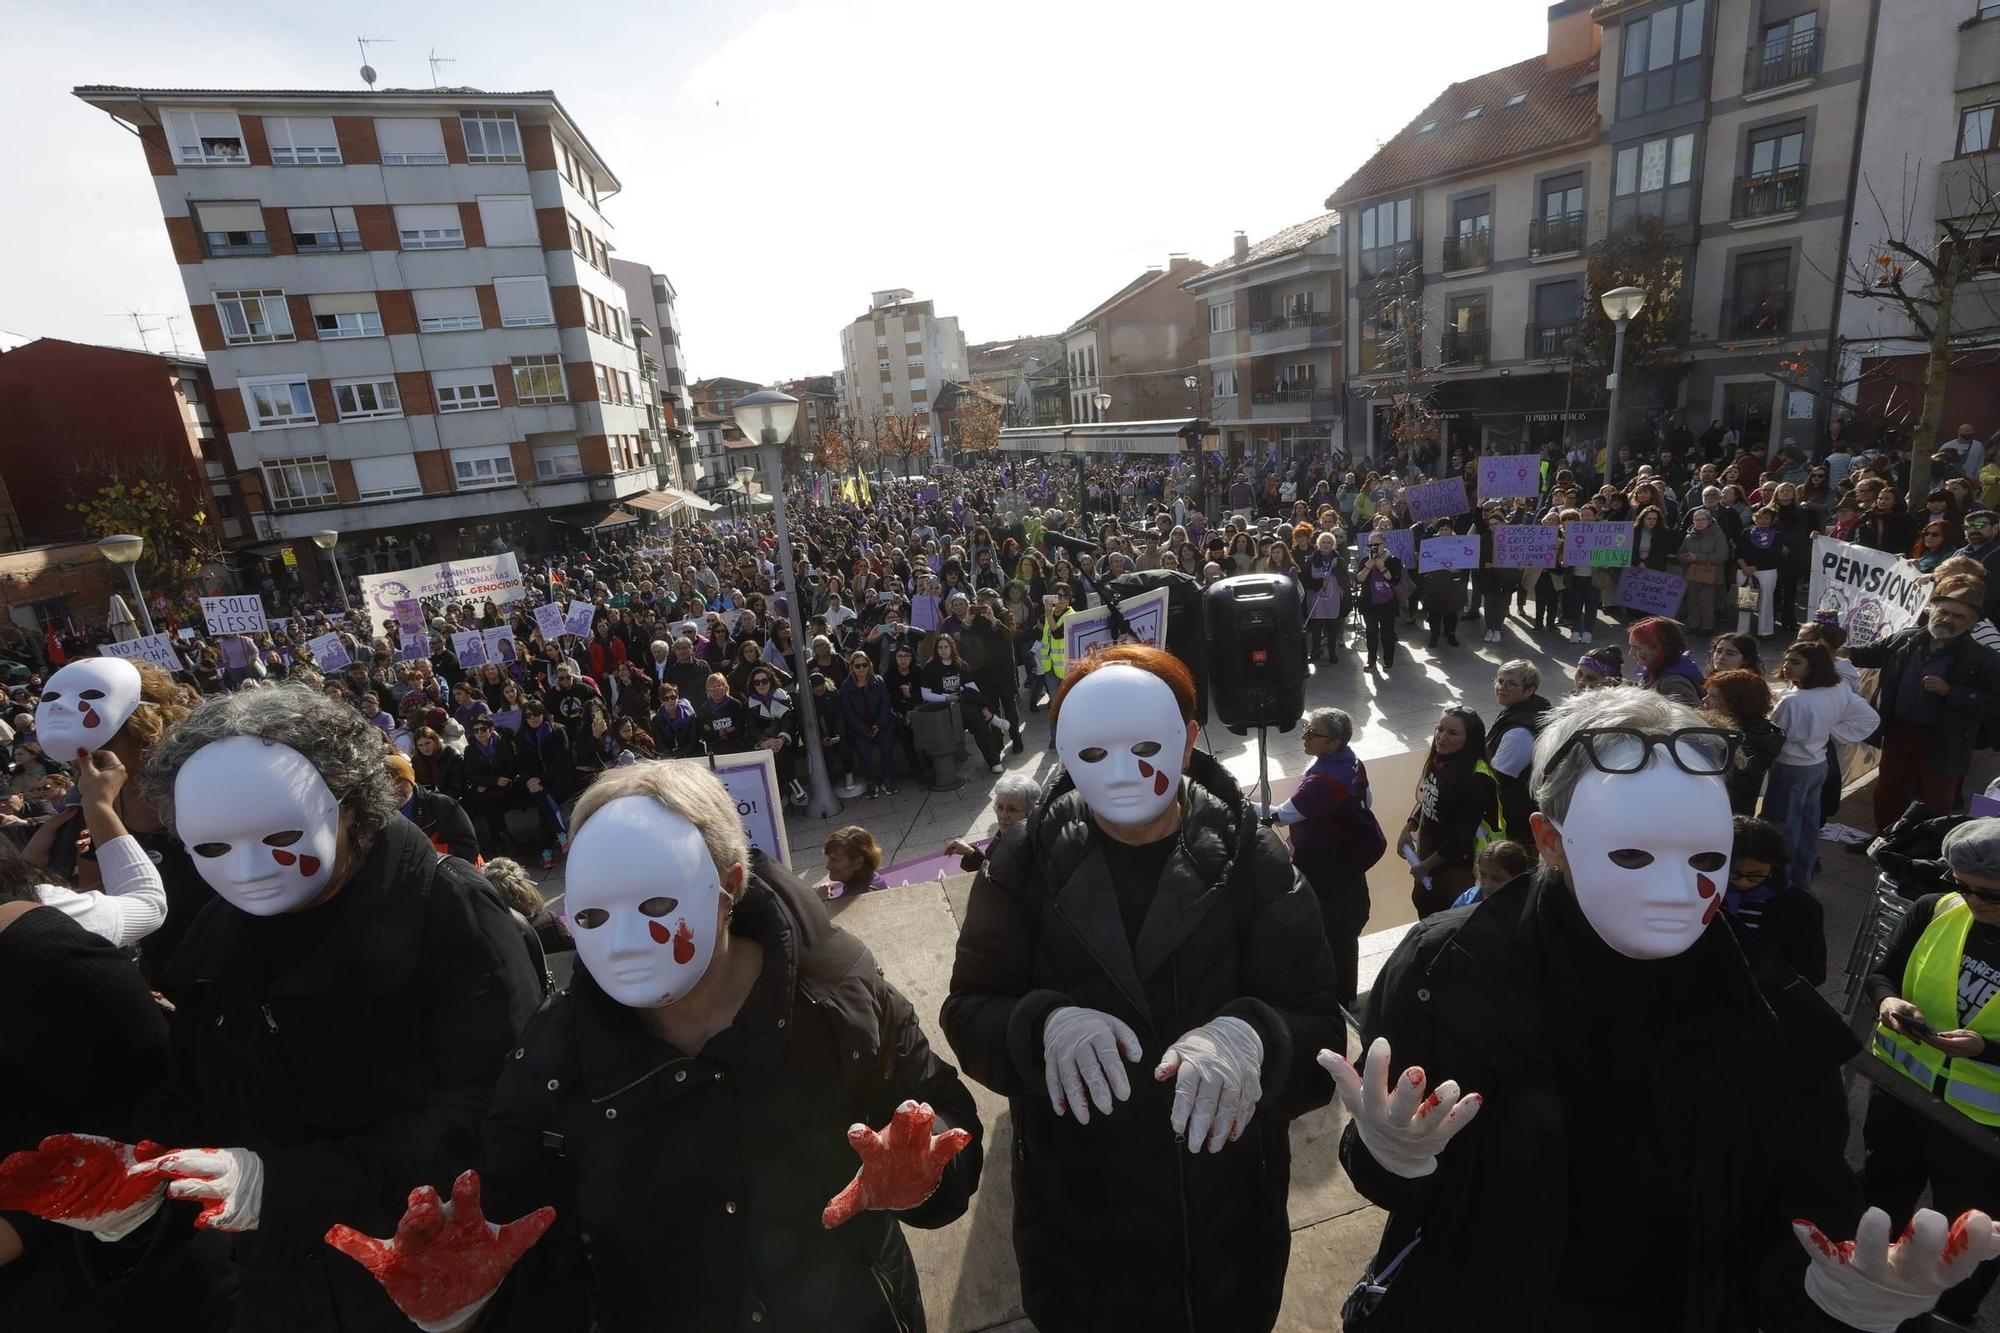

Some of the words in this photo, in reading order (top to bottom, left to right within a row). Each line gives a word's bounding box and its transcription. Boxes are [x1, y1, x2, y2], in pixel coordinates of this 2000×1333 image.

[1410, 480, 1458, 498] QUIERO
[1502, 526, 1536, 536] SOMOS
[1540, 526, 1551, 536] EL
[1572, 523, 1594, 533] SIN
[1598, 522, 1626, 533] LUCHA
[1508, 536, 1534, 544] GRITO
[1594, 536, 1612, 546] NO
[1509, 544, 1523, 552] LAS
[1528, 544, 1545, 552] QUE
[436, 564, 493, 580] FEMINISTAS
[420, 571, 510, 594] REVOLUCIONARIAS
[419, 592, 453, 604] ONTRA
[454, 590, 467, 598] EL
[470, 580, 520, 595] GENOCIDIO
[204, 597, 260, 614] #SOLO
[465, 594, 493, 606] GAZA
[110, 643, 130, 656] NO
[134, 640, 142, 651] A
[144, 636, 162, 649] LA
